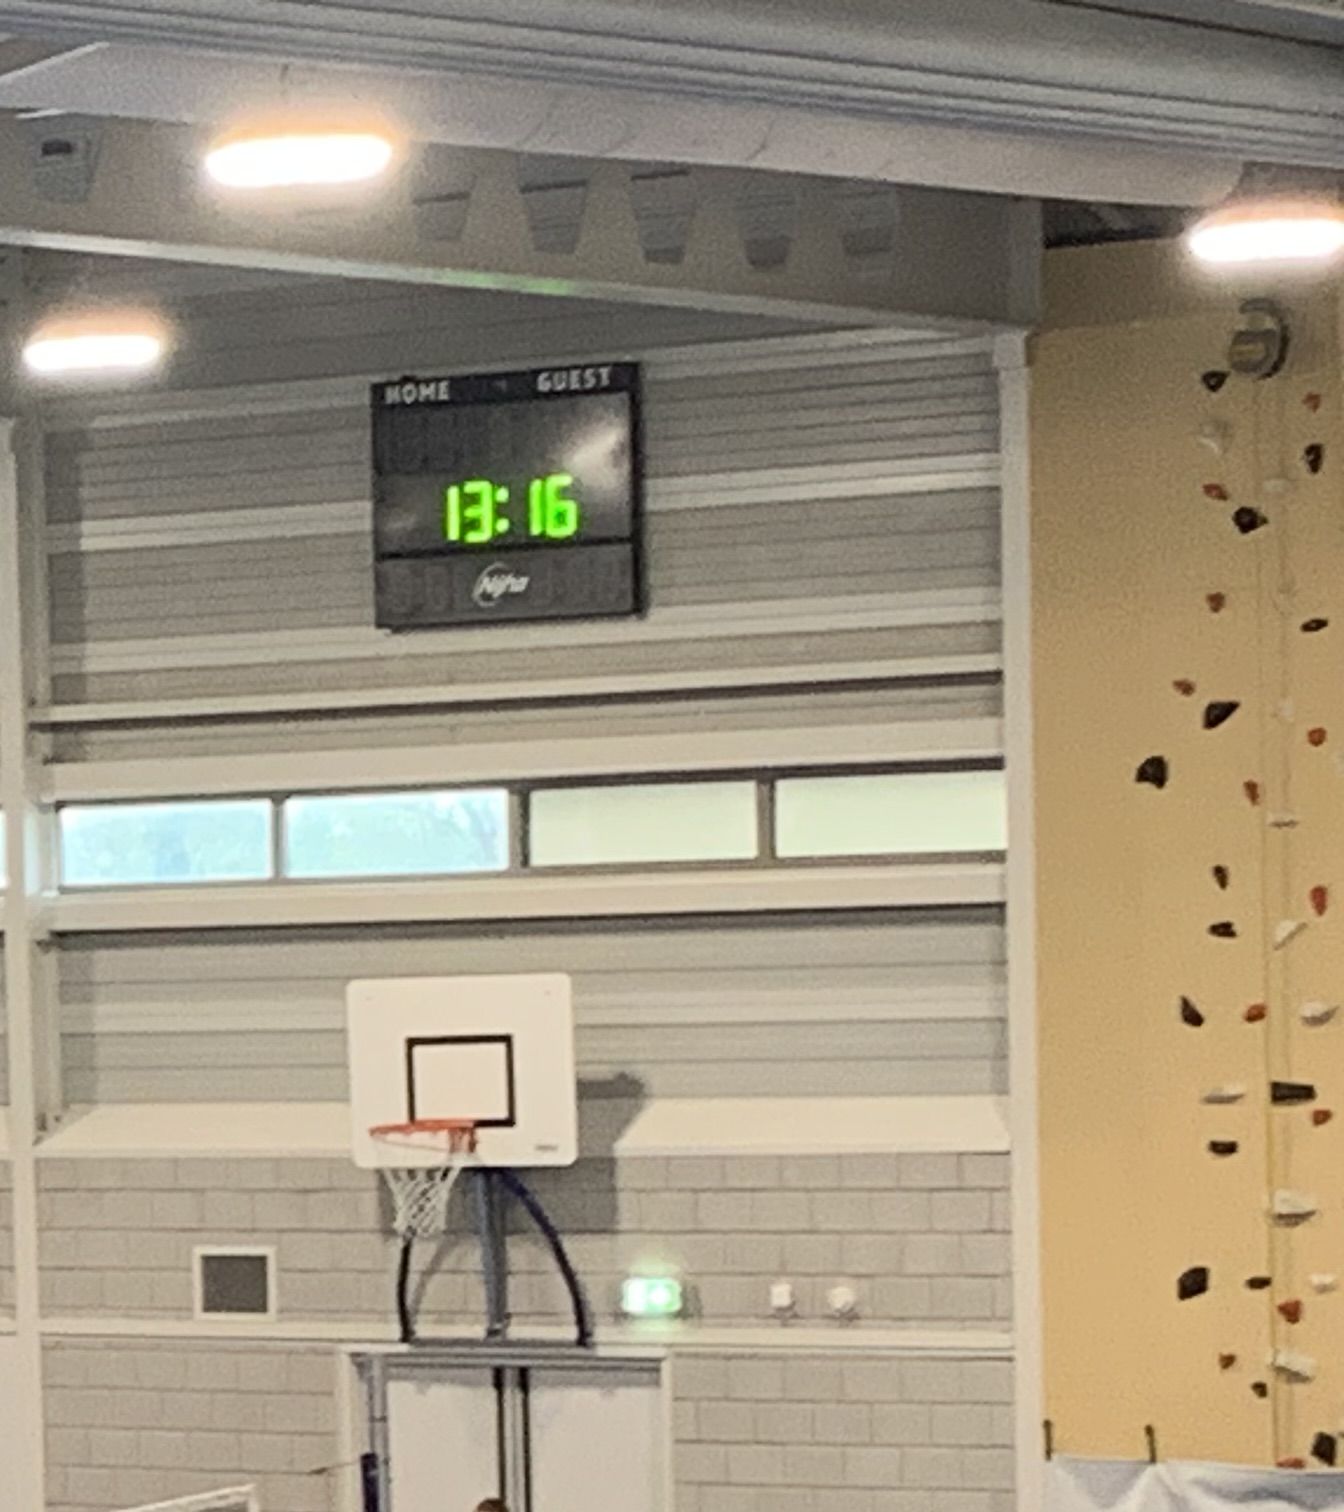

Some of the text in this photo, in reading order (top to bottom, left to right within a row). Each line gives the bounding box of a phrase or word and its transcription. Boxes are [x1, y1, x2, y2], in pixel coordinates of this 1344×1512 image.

[385, 381, 451, 404] HOME
[537, 367, 611, 393] GUEST
[446, 473, 578, 543] 13:16
